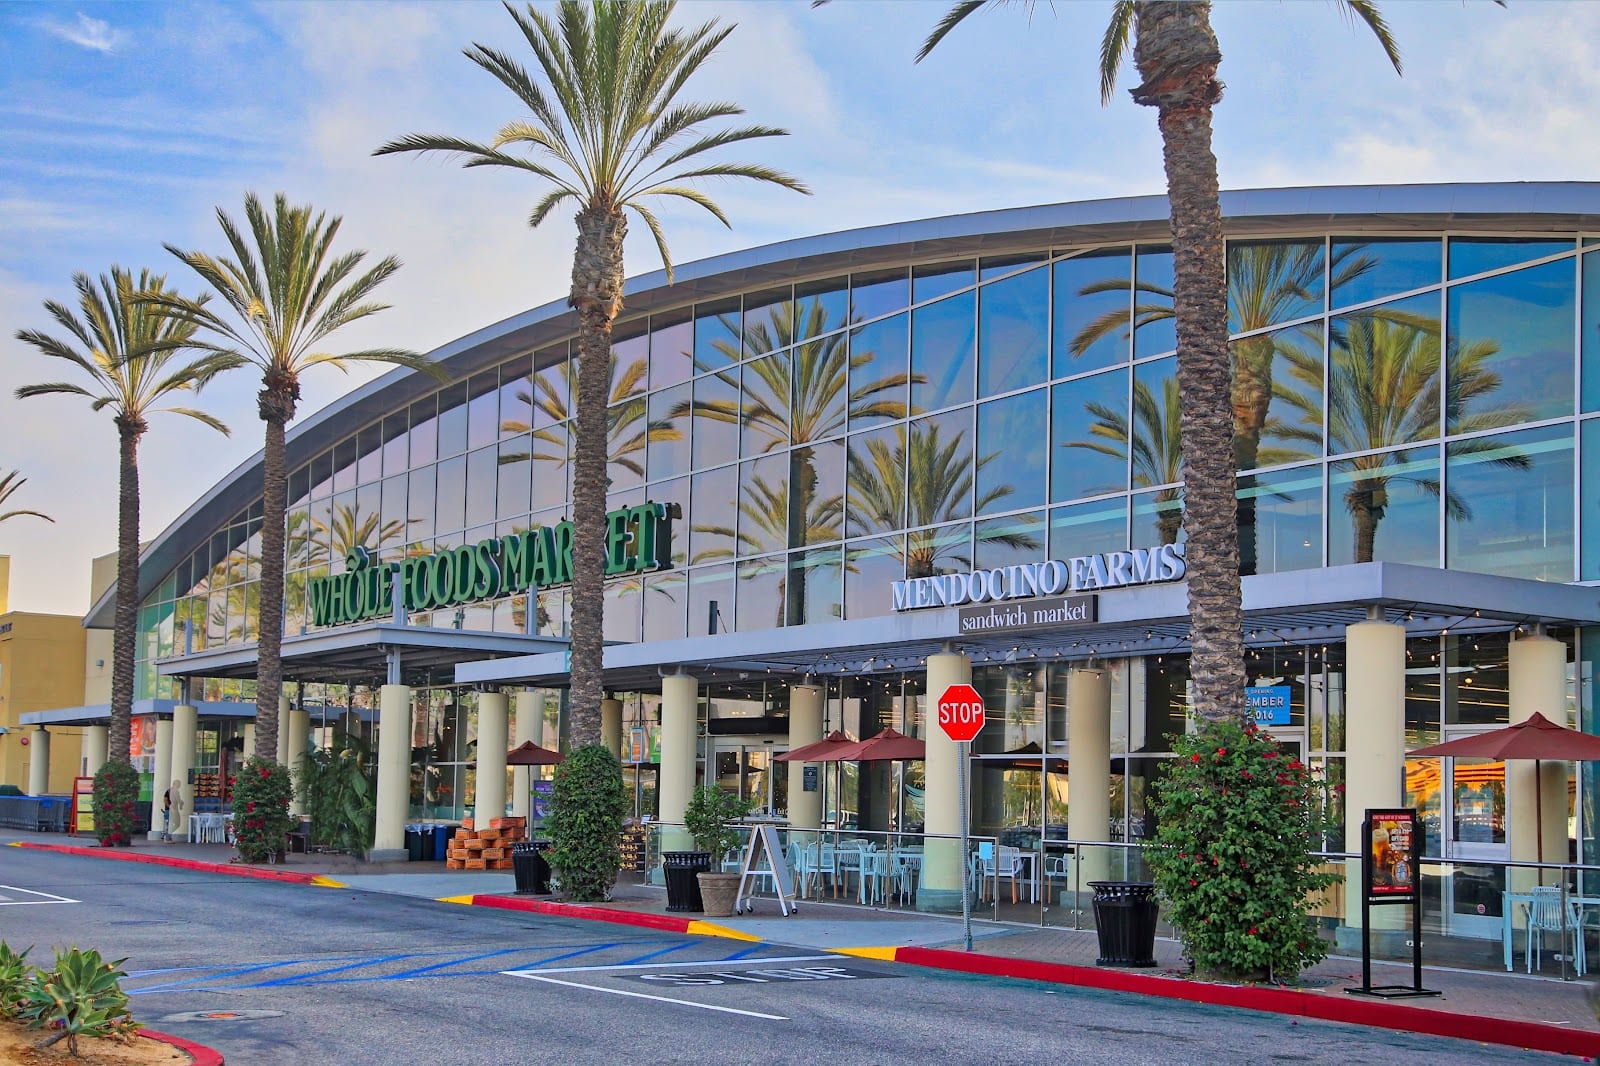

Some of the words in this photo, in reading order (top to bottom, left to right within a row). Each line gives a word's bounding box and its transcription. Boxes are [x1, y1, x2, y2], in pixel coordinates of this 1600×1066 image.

[309, 546, 400, 627] WHOLE
[401, 538, 500, 613] FOODS
[502, 501, 667, 592] MARET
[891, 560, 1069, 611] MENDOCINO
[1069, 543, 1187, 592] FARMS
[962, 607, 1028, 630] sandwich
[1033, 600, 1087, 623] market
[940, 702, 982, 724] STOP
[1246, 696, 1284, 707] EMBER
